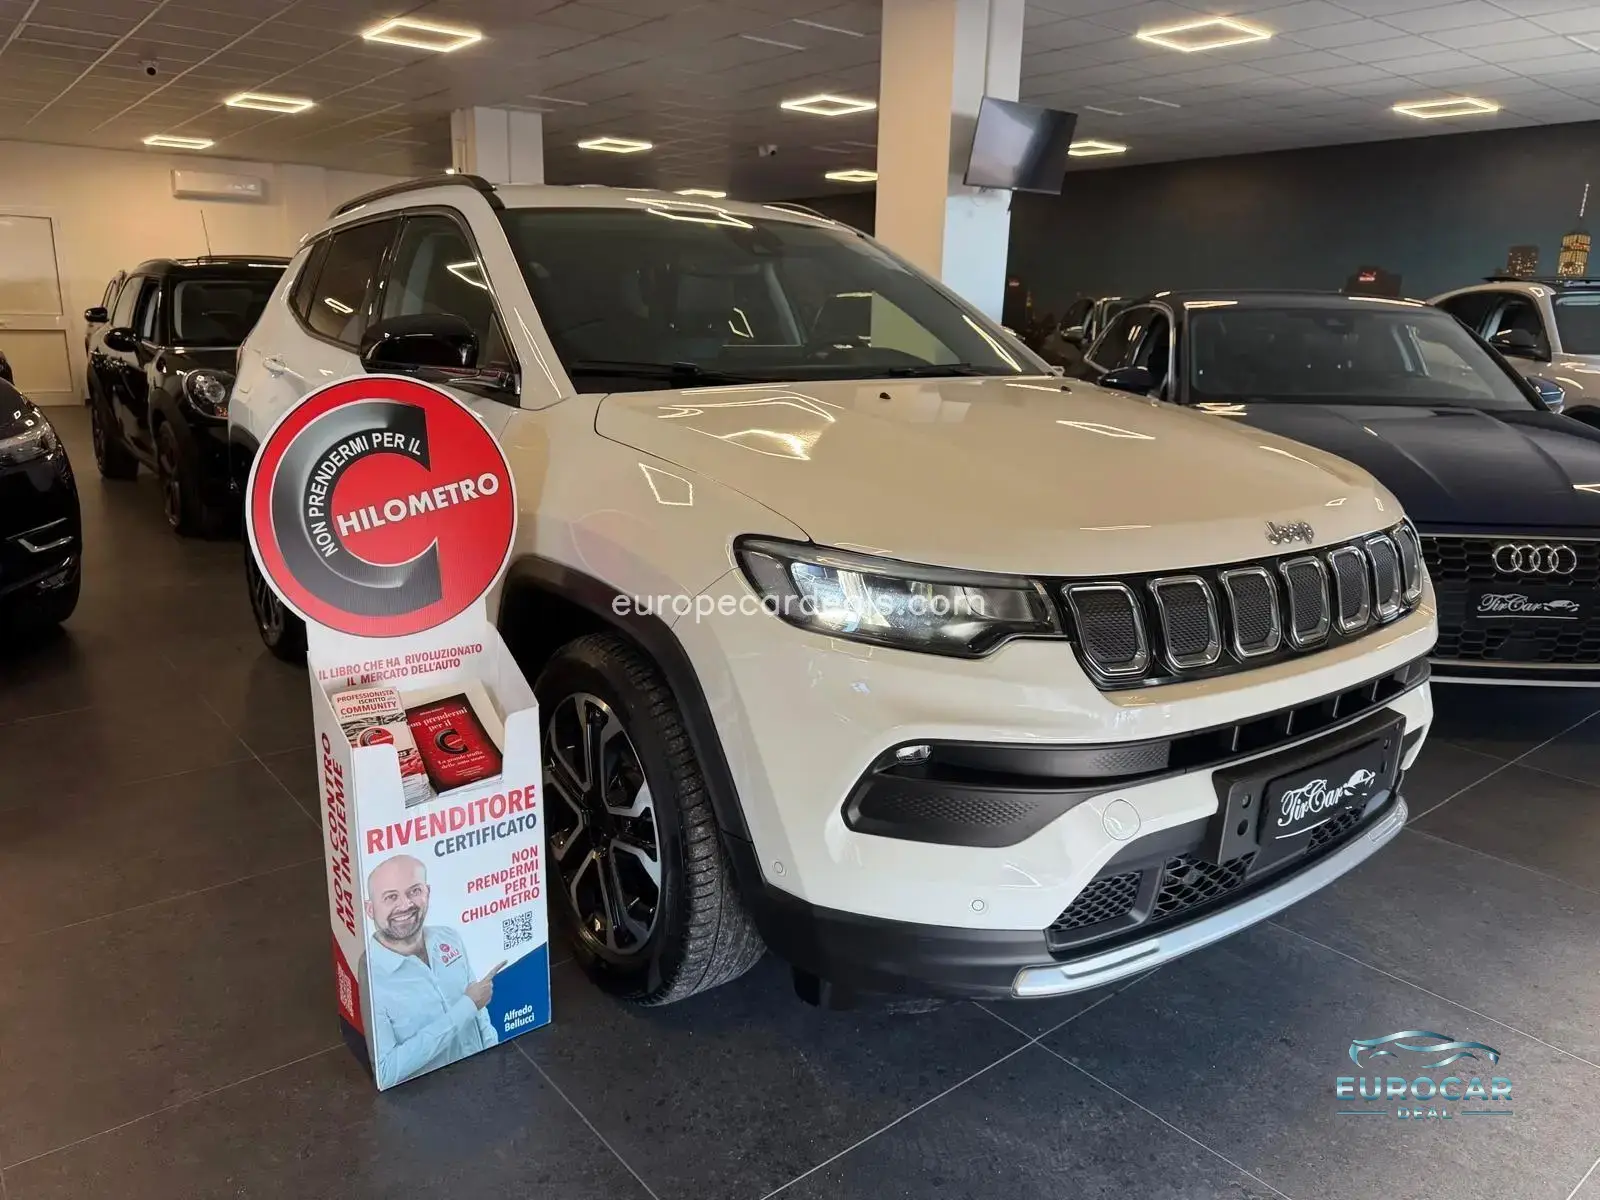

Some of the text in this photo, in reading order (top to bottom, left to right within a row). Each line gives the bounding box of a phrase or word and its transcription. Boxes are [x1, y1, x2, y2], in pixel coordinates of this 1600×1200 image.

[309, 432, 422, 558] NON PRENDERMI PER IL
[1265, 521, 1314, 545] Jeep
[318, 643, 482, 681] IL LIBRO CHE HA RIVOLUZIONATO
[347, 658, 460, 687] IL MERCATO DELL'AUTO
[336, 689, 394, 704] PROFESSIONISTA
[340, 701, 397, 715] COMMUNITY
[358, 696, 386, 705] ISCRITTO
[321, 732, 345, 922] NON CONTRO
[366, 785, 537, 854] RIVENDITORE
[332, 758, 356, 937] MA INSIEME
[433, 813, 537, 857] CERTIFICATO
[511, 845, 538, 864] NON
[467, 859, 539, 893] PRENDERMI
[504, 873, 540, 894] PER IL
[461, 887, 540, 923] CHILOMETRO
[504, 1004, 532, 1022] Alfredo
[504, 1012, 535, 1032] Bellucci
